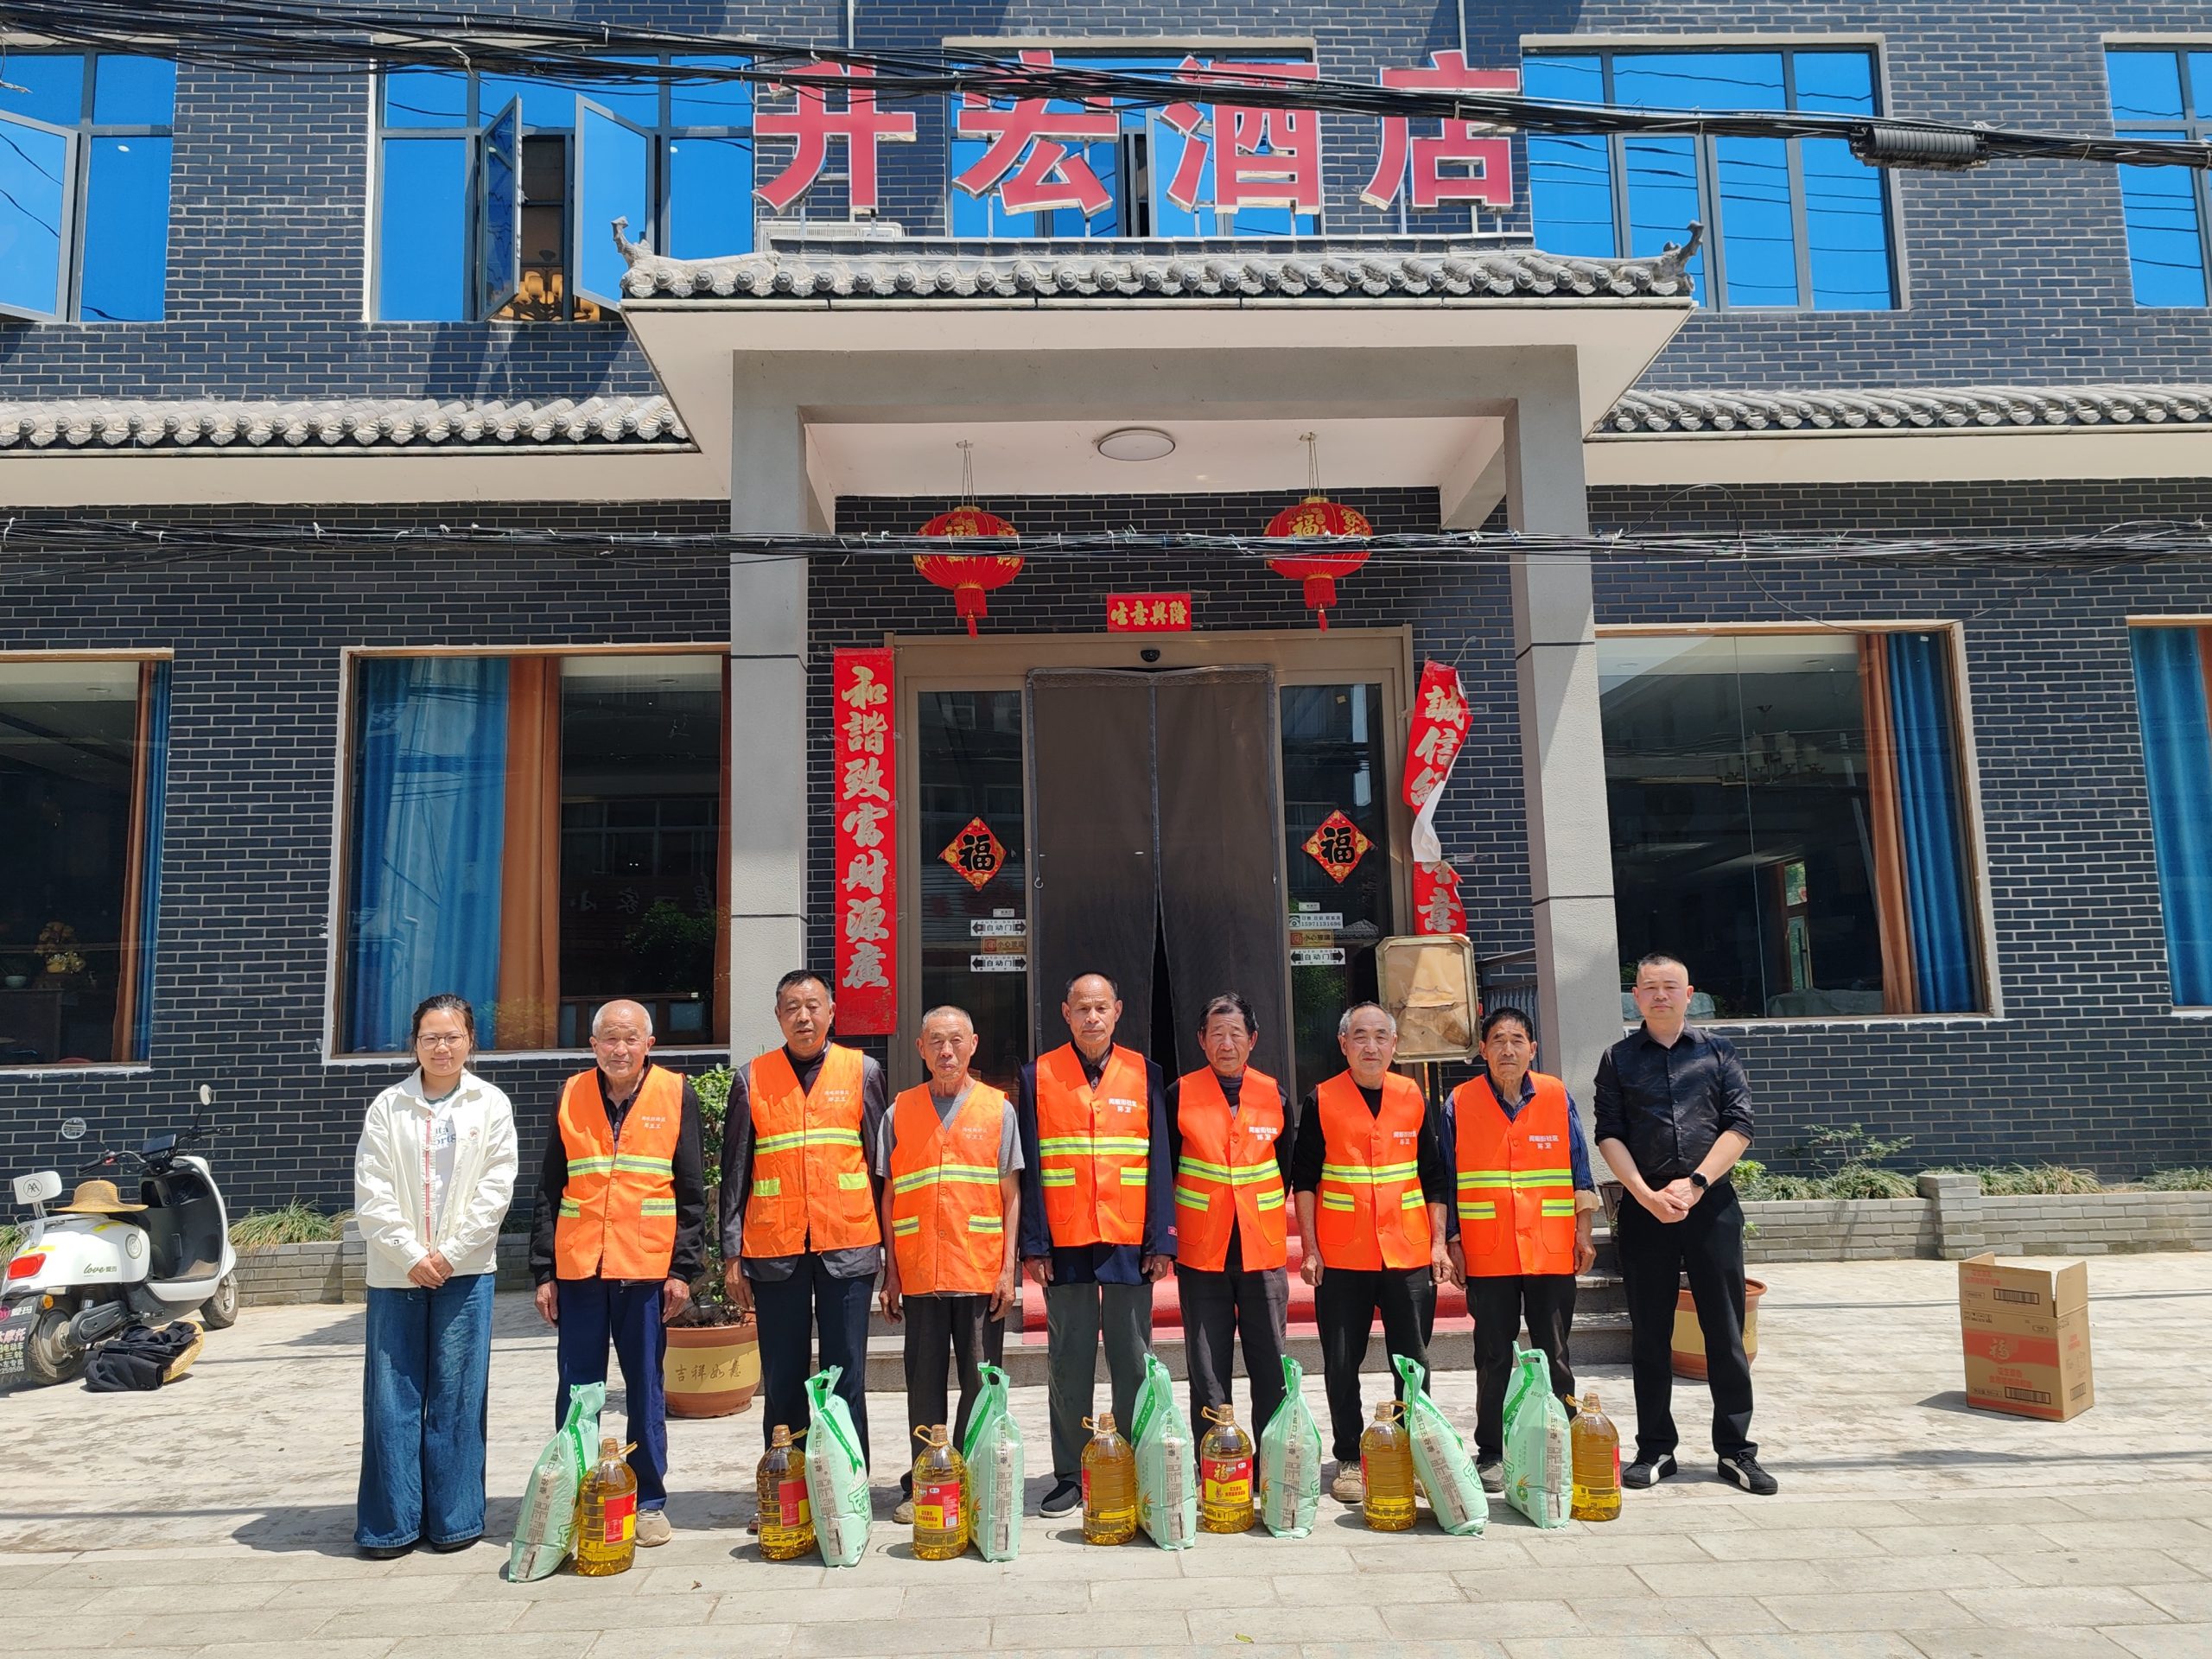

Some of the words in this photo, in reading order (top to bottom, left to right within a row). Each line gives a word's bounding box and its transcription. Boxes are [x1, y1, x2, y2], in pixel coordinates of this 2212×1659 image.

[958, 833, 995, 873] 福
[1319, 826, 1355, 864] 福
[676, 1360, 741, 1382] 吉祥如意
